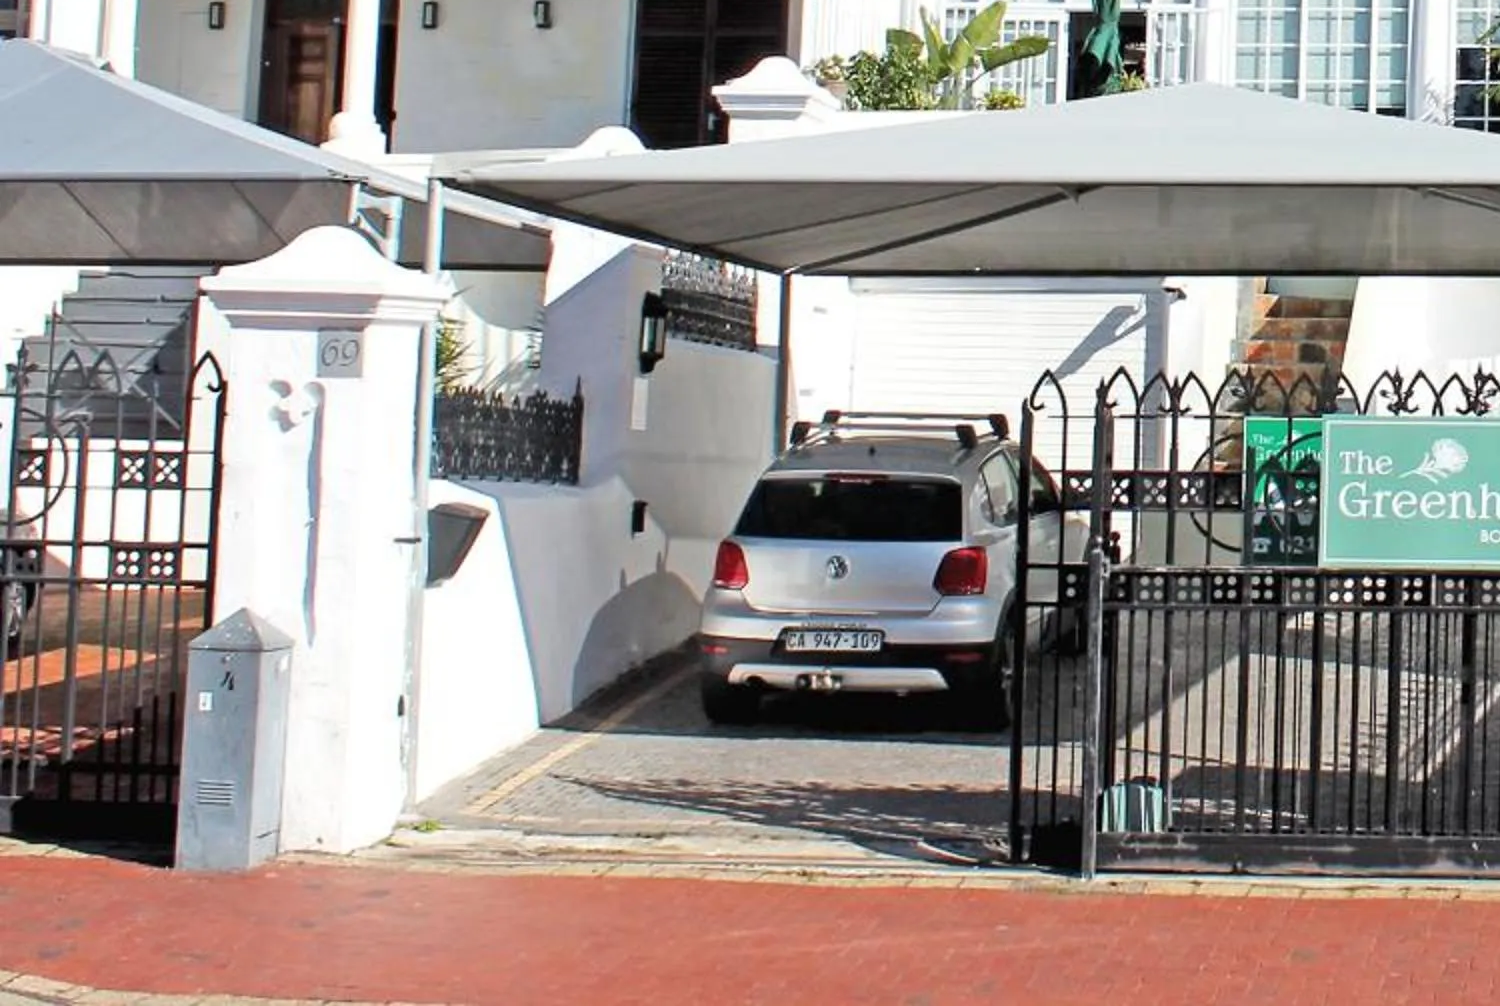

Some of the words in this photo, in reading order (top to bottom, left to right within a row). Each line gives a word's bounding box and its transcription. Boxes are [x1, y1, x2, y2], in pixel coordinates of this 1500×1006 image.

[321, 339, 360, 367] 69
[1339, 450, 1393, 475] The
[788, 633, 805, 648] CA
[814, 632, 879, 648] 947-109
